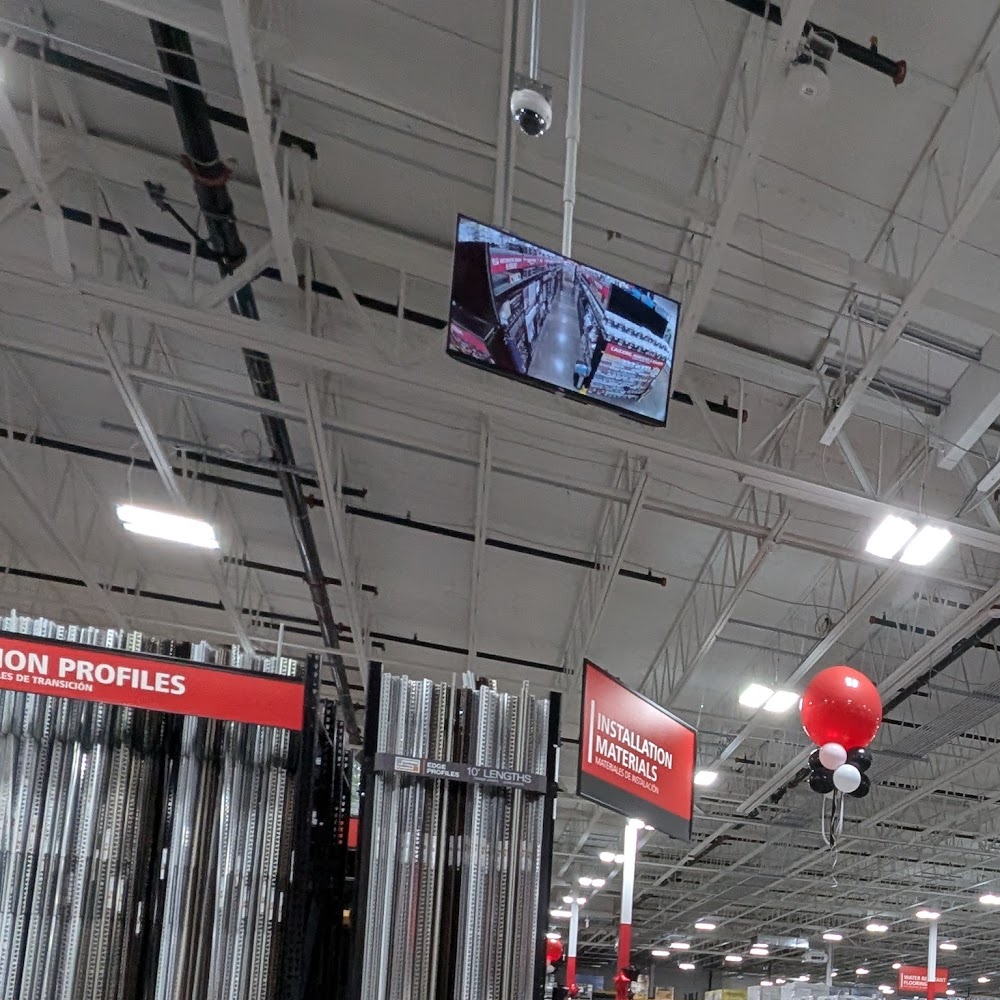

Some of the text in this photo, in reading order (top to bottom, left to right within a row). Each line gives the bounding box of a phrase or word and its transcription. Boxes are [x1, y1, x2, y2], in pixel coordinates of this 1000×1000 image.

[16, 673, 30, 683] DE
[32, 675, 93, 692] TRANSICIÓN
[59, 657, 186, 695] PROFILES
[597, 712, 673, 770] INSTALLATION
[595, 756, 625, 778] MATERIALES
[625, 771, 631, 781] DE
[596, 735, 657, 782] MATERIALS
[427, 762, 446, 770] EDGE
[483, 770, 531, 784] LENGTHS
[427, 768, 460, 778] PROFILES
